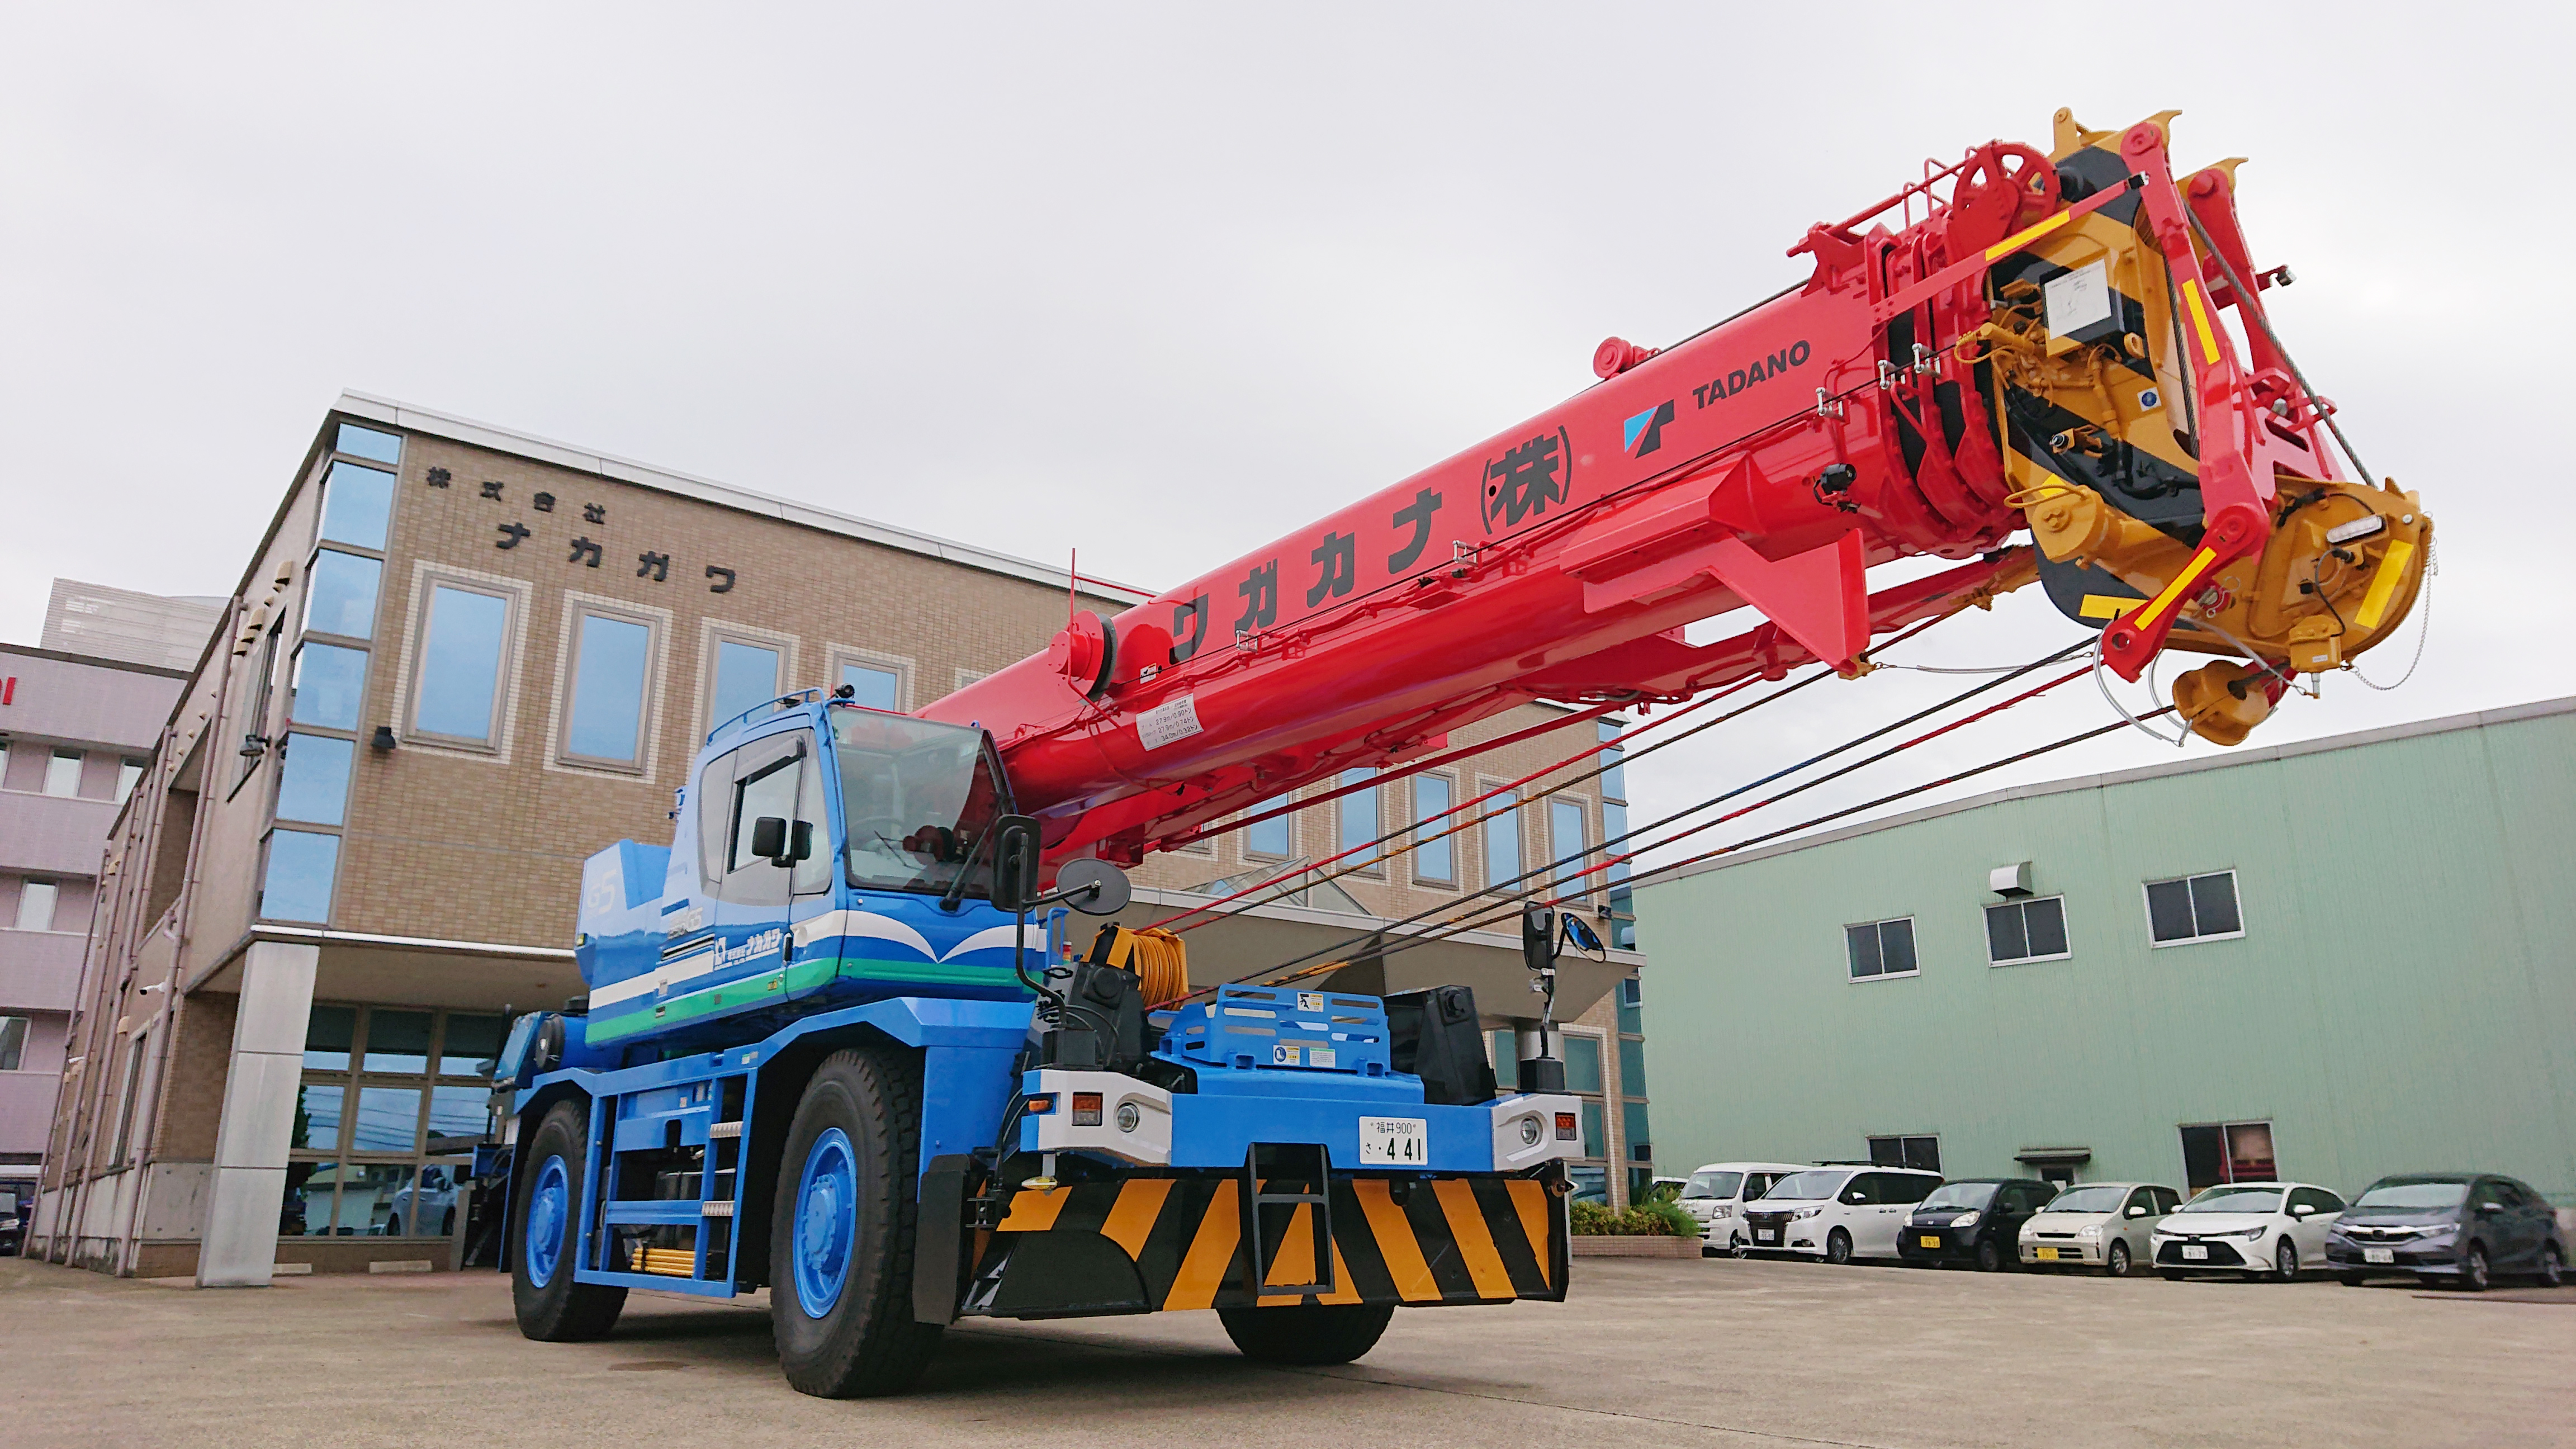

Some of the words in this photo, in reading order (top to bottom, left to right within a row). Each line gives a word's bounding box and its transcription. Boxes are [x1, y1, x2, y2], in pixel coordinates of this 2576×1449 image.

[1693, 341, 1810, 409] TADANO
[427, 467, 606, 525] 株式会社
[496, 522, 737, 594] ナカガワ
